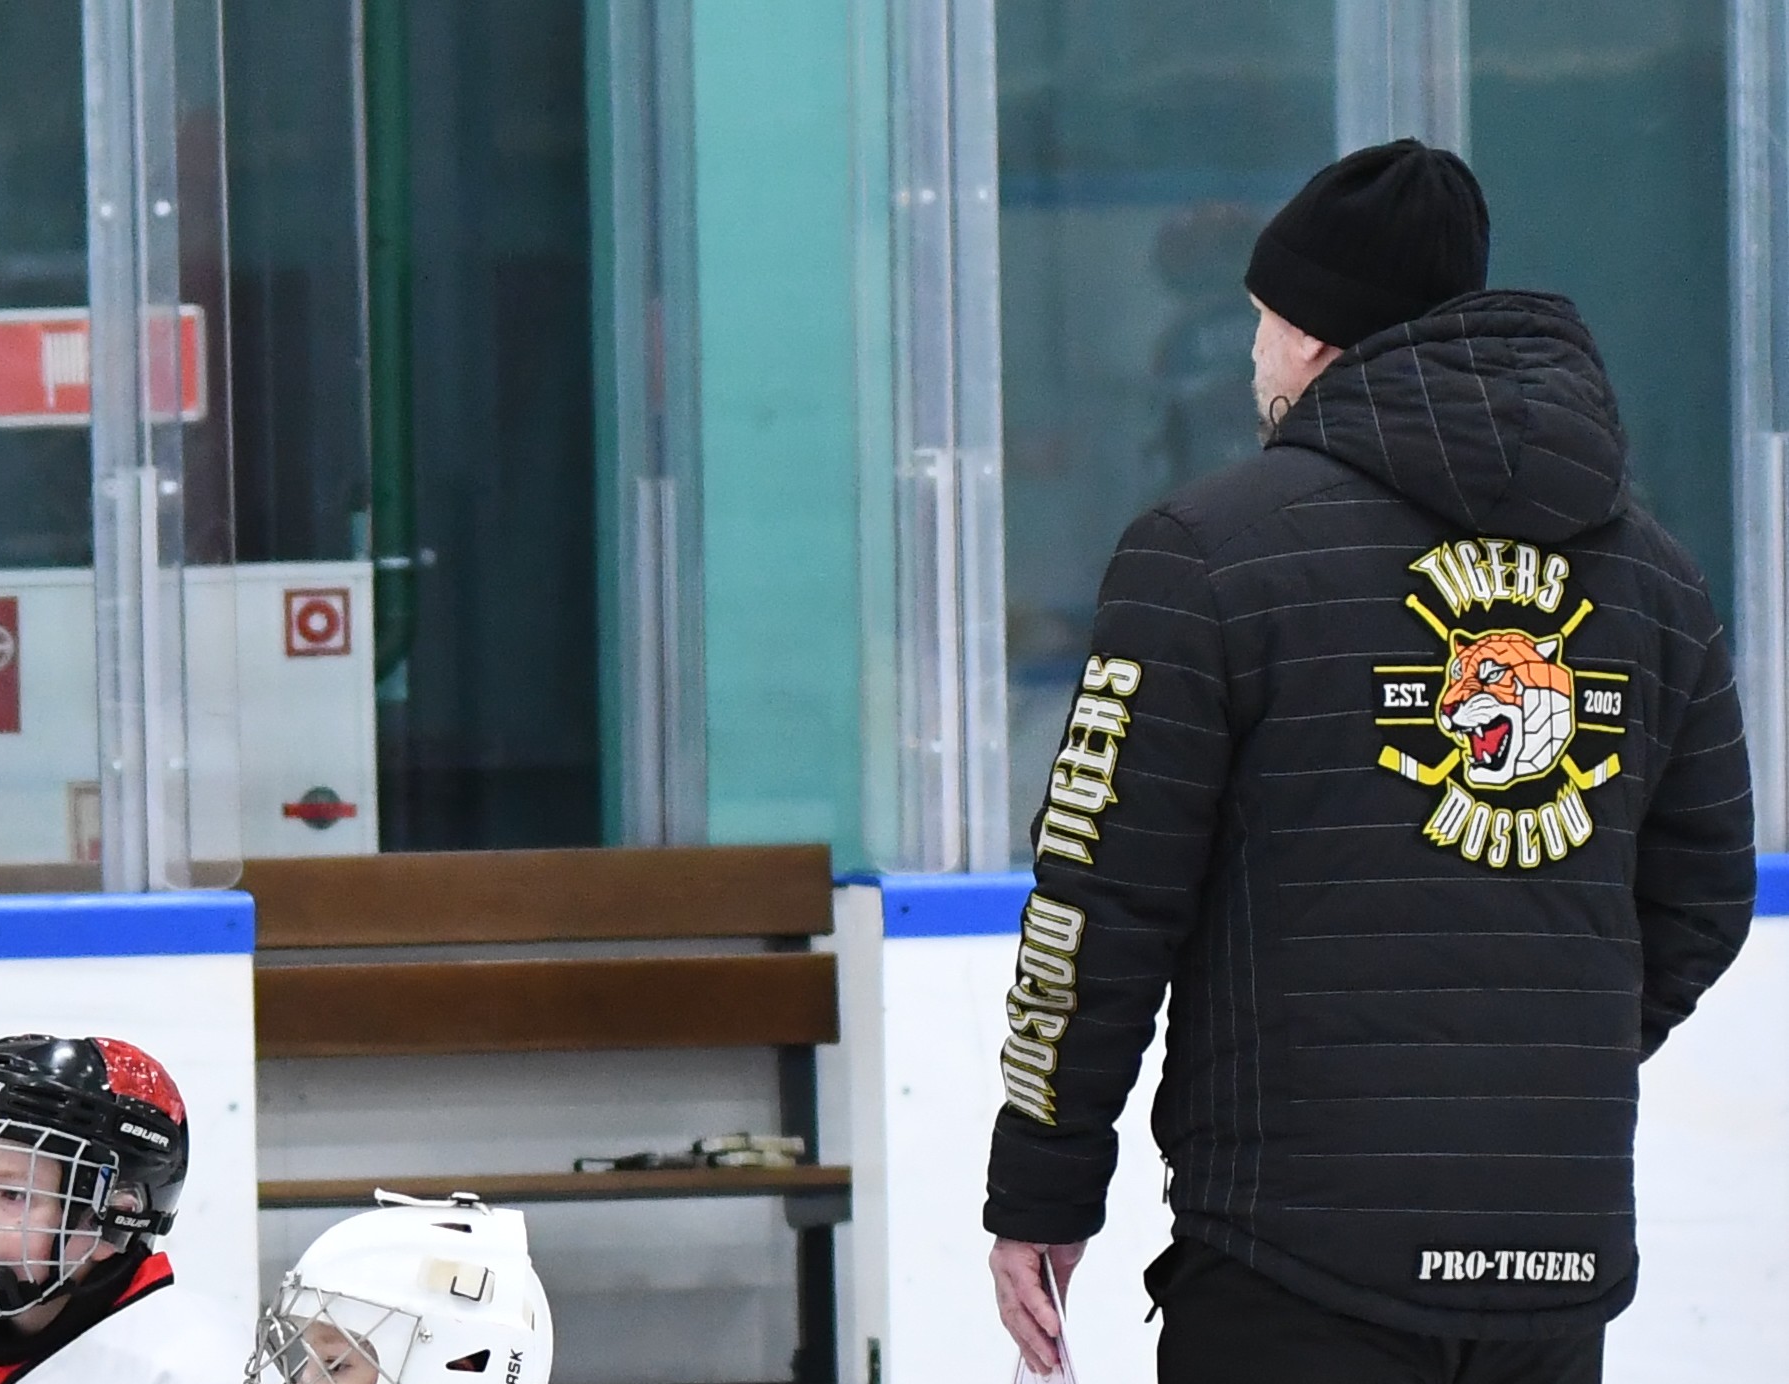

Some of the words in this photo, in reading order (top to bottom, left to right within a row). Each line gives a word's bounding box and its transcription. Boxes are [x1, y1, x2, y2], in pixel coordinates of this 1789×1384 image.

[1410, 538, 1570, 616] TIGERS
[1384, 683, 1429, 709] EST.
[1584, 690, 1622, 716] 2003
[1038, 655, 1141, 864] TIGERS
[1424, 782, 1594, 869] MOSCOW
[1001, 893, 1086, 1127] MOSCOW
[120, 1122, 170, 1147] BAUER
[1418, 1250, 1597, 1282] PRO-TIGERS
